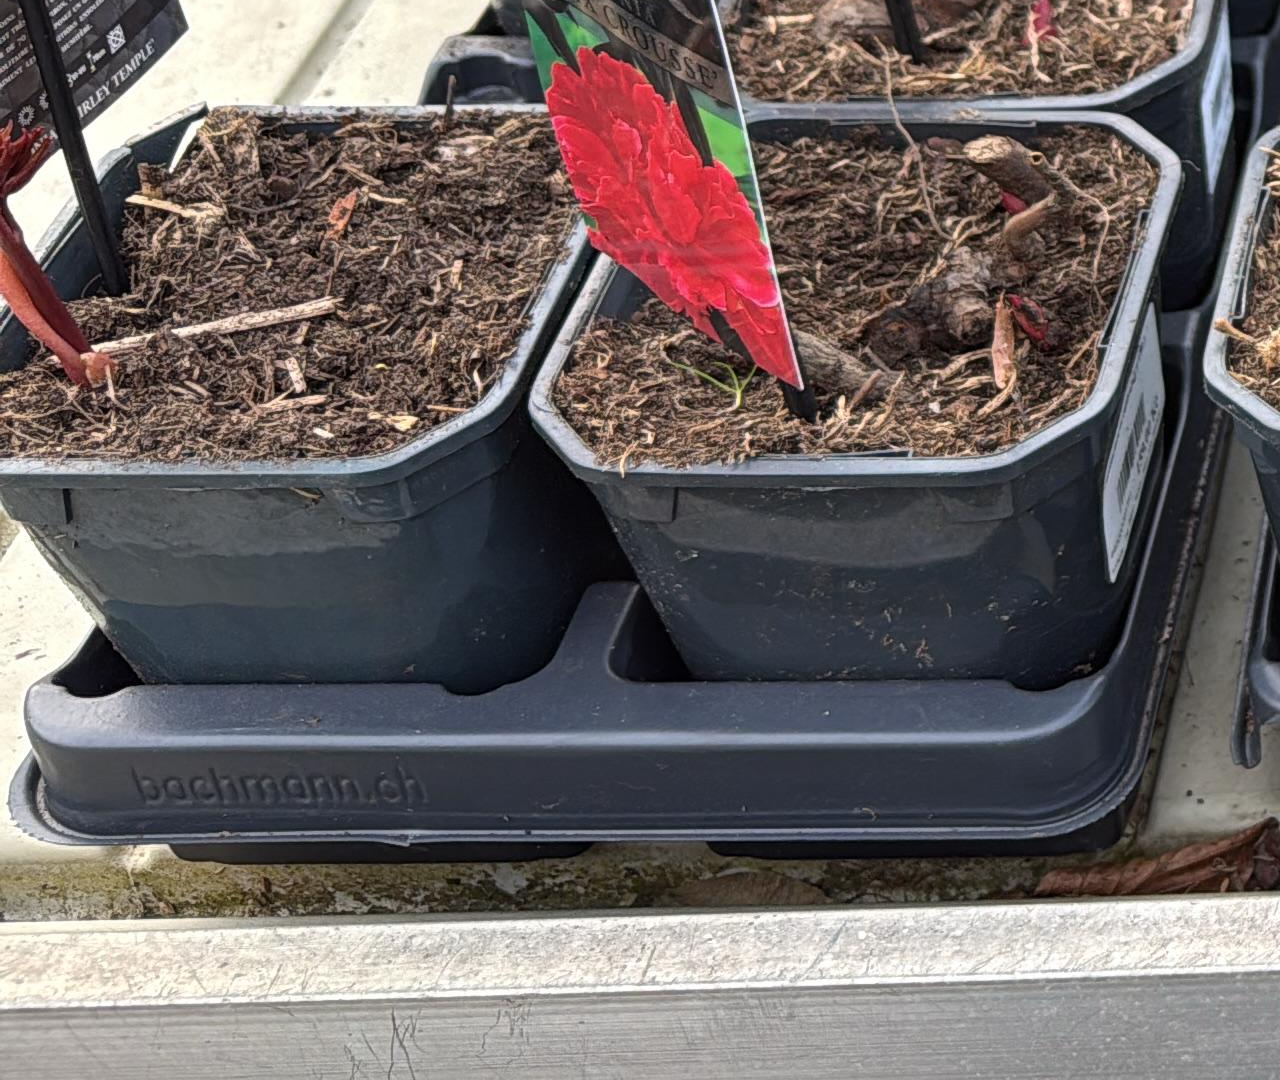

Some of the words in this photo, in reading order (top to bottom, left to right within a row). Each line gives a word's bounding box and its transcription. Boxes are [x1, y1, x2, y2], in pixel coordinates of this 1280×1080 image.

[77, 80, 112, 119] IRLEY
[111, 37, 156, 87] TEMPLE'
[602, 4, 718, 90] CROUSSE'
[130, 765, 430, 806] bachmann.ch
